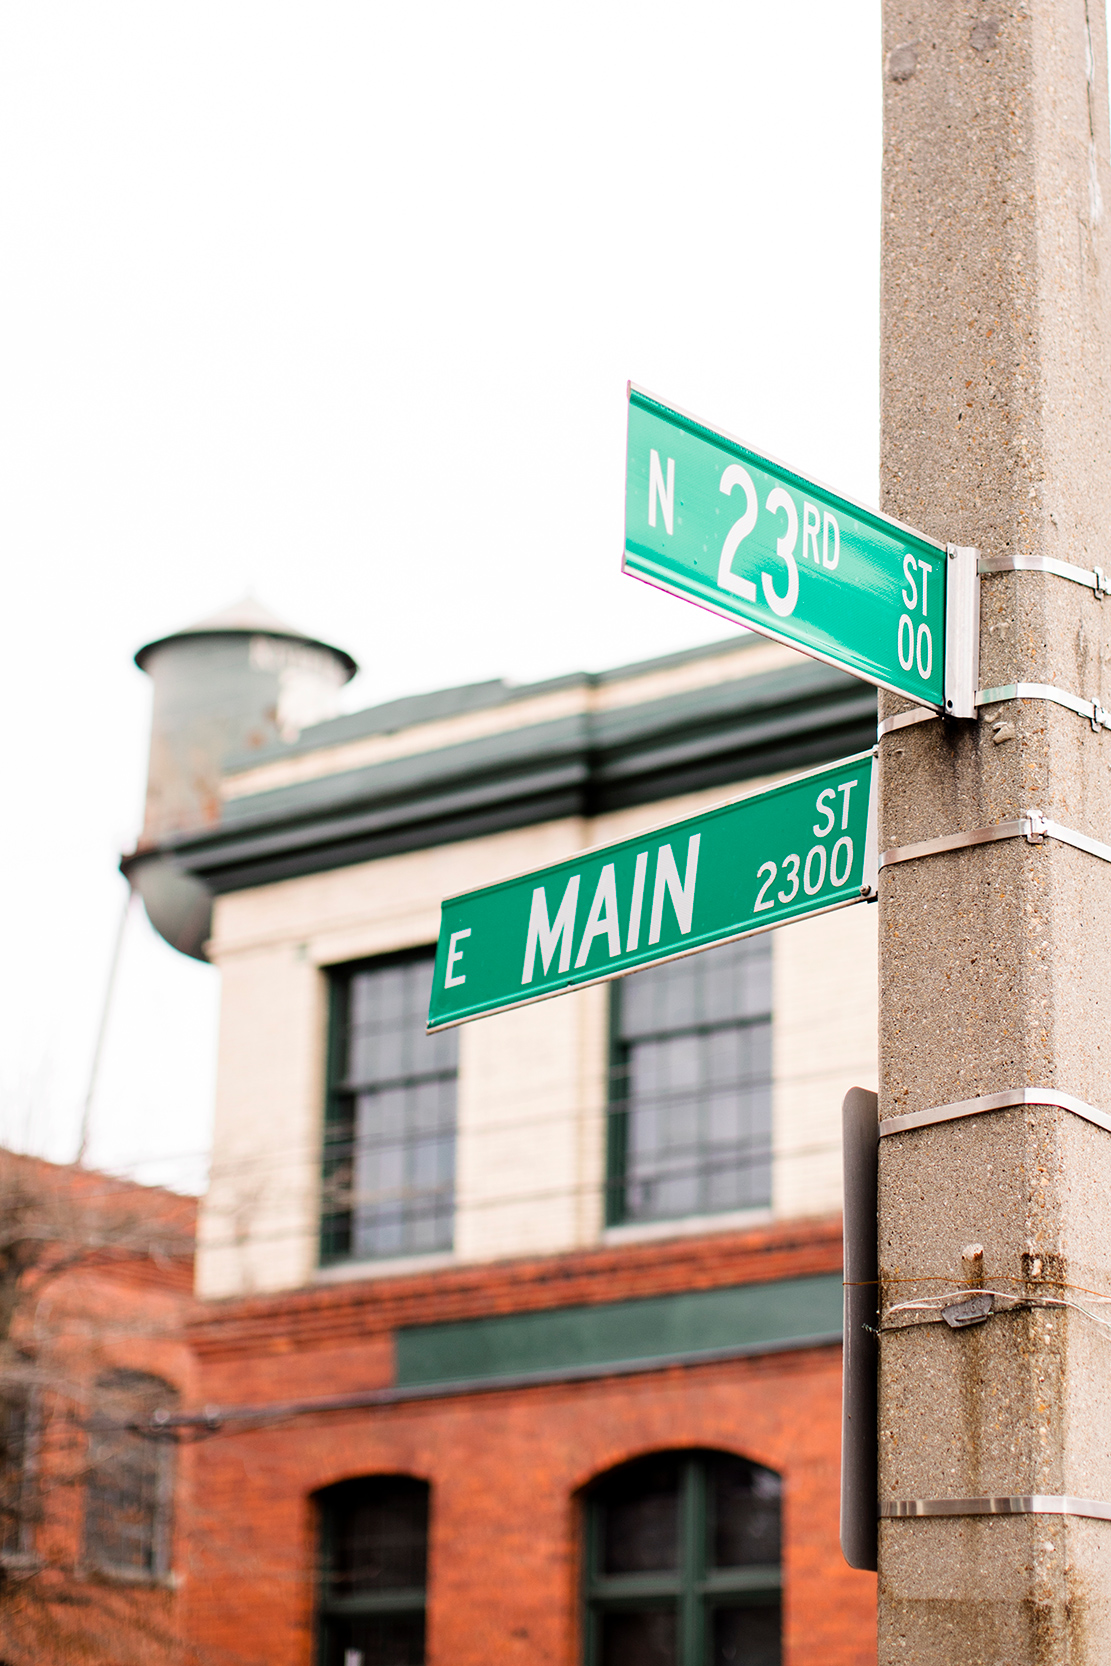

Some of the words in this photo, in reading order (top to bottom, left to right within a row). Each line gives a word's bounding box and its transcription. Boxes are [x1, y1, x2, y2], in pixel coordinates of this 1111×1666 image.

[647, 448, 676, 536] N
[901, 553, 933, 617] ST
[897, 613, 933, 680] 00
[444, 928, 472, 989] E
[521, 832, 702, 986] MAIN
[812, 779, 859, 838] ST
[753, 836, 854, 913] 2300
